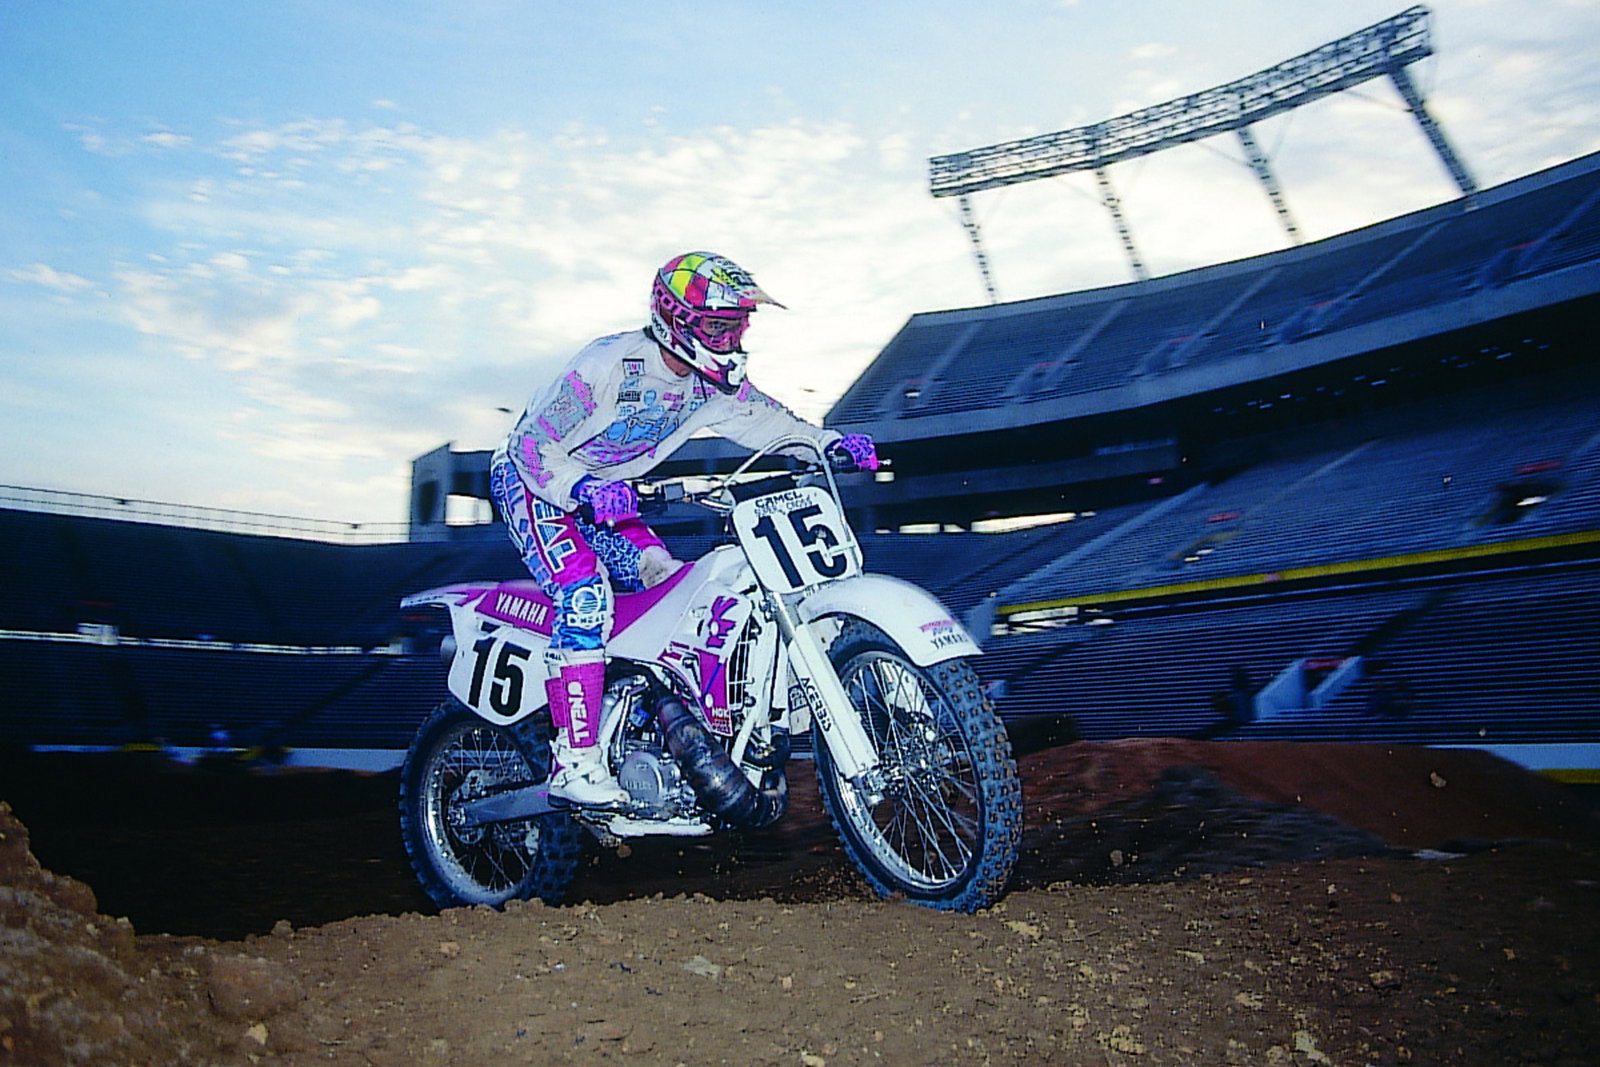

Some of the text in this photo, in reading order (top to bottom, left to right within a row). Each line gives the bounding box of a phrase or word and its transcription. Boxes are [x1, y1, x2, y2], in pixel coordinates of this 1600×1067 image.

[654, 284, 702, 323] COTT
[755, 490, 802, 508] CAMEL
[531, 497, 577, 574] EAL
[751, 503, 848, 589] 15
[495, 591, 549, 627] YAMAHA
[468, 635, 532, 717] 15
[800, 677, 832, 732] ACERBIS
